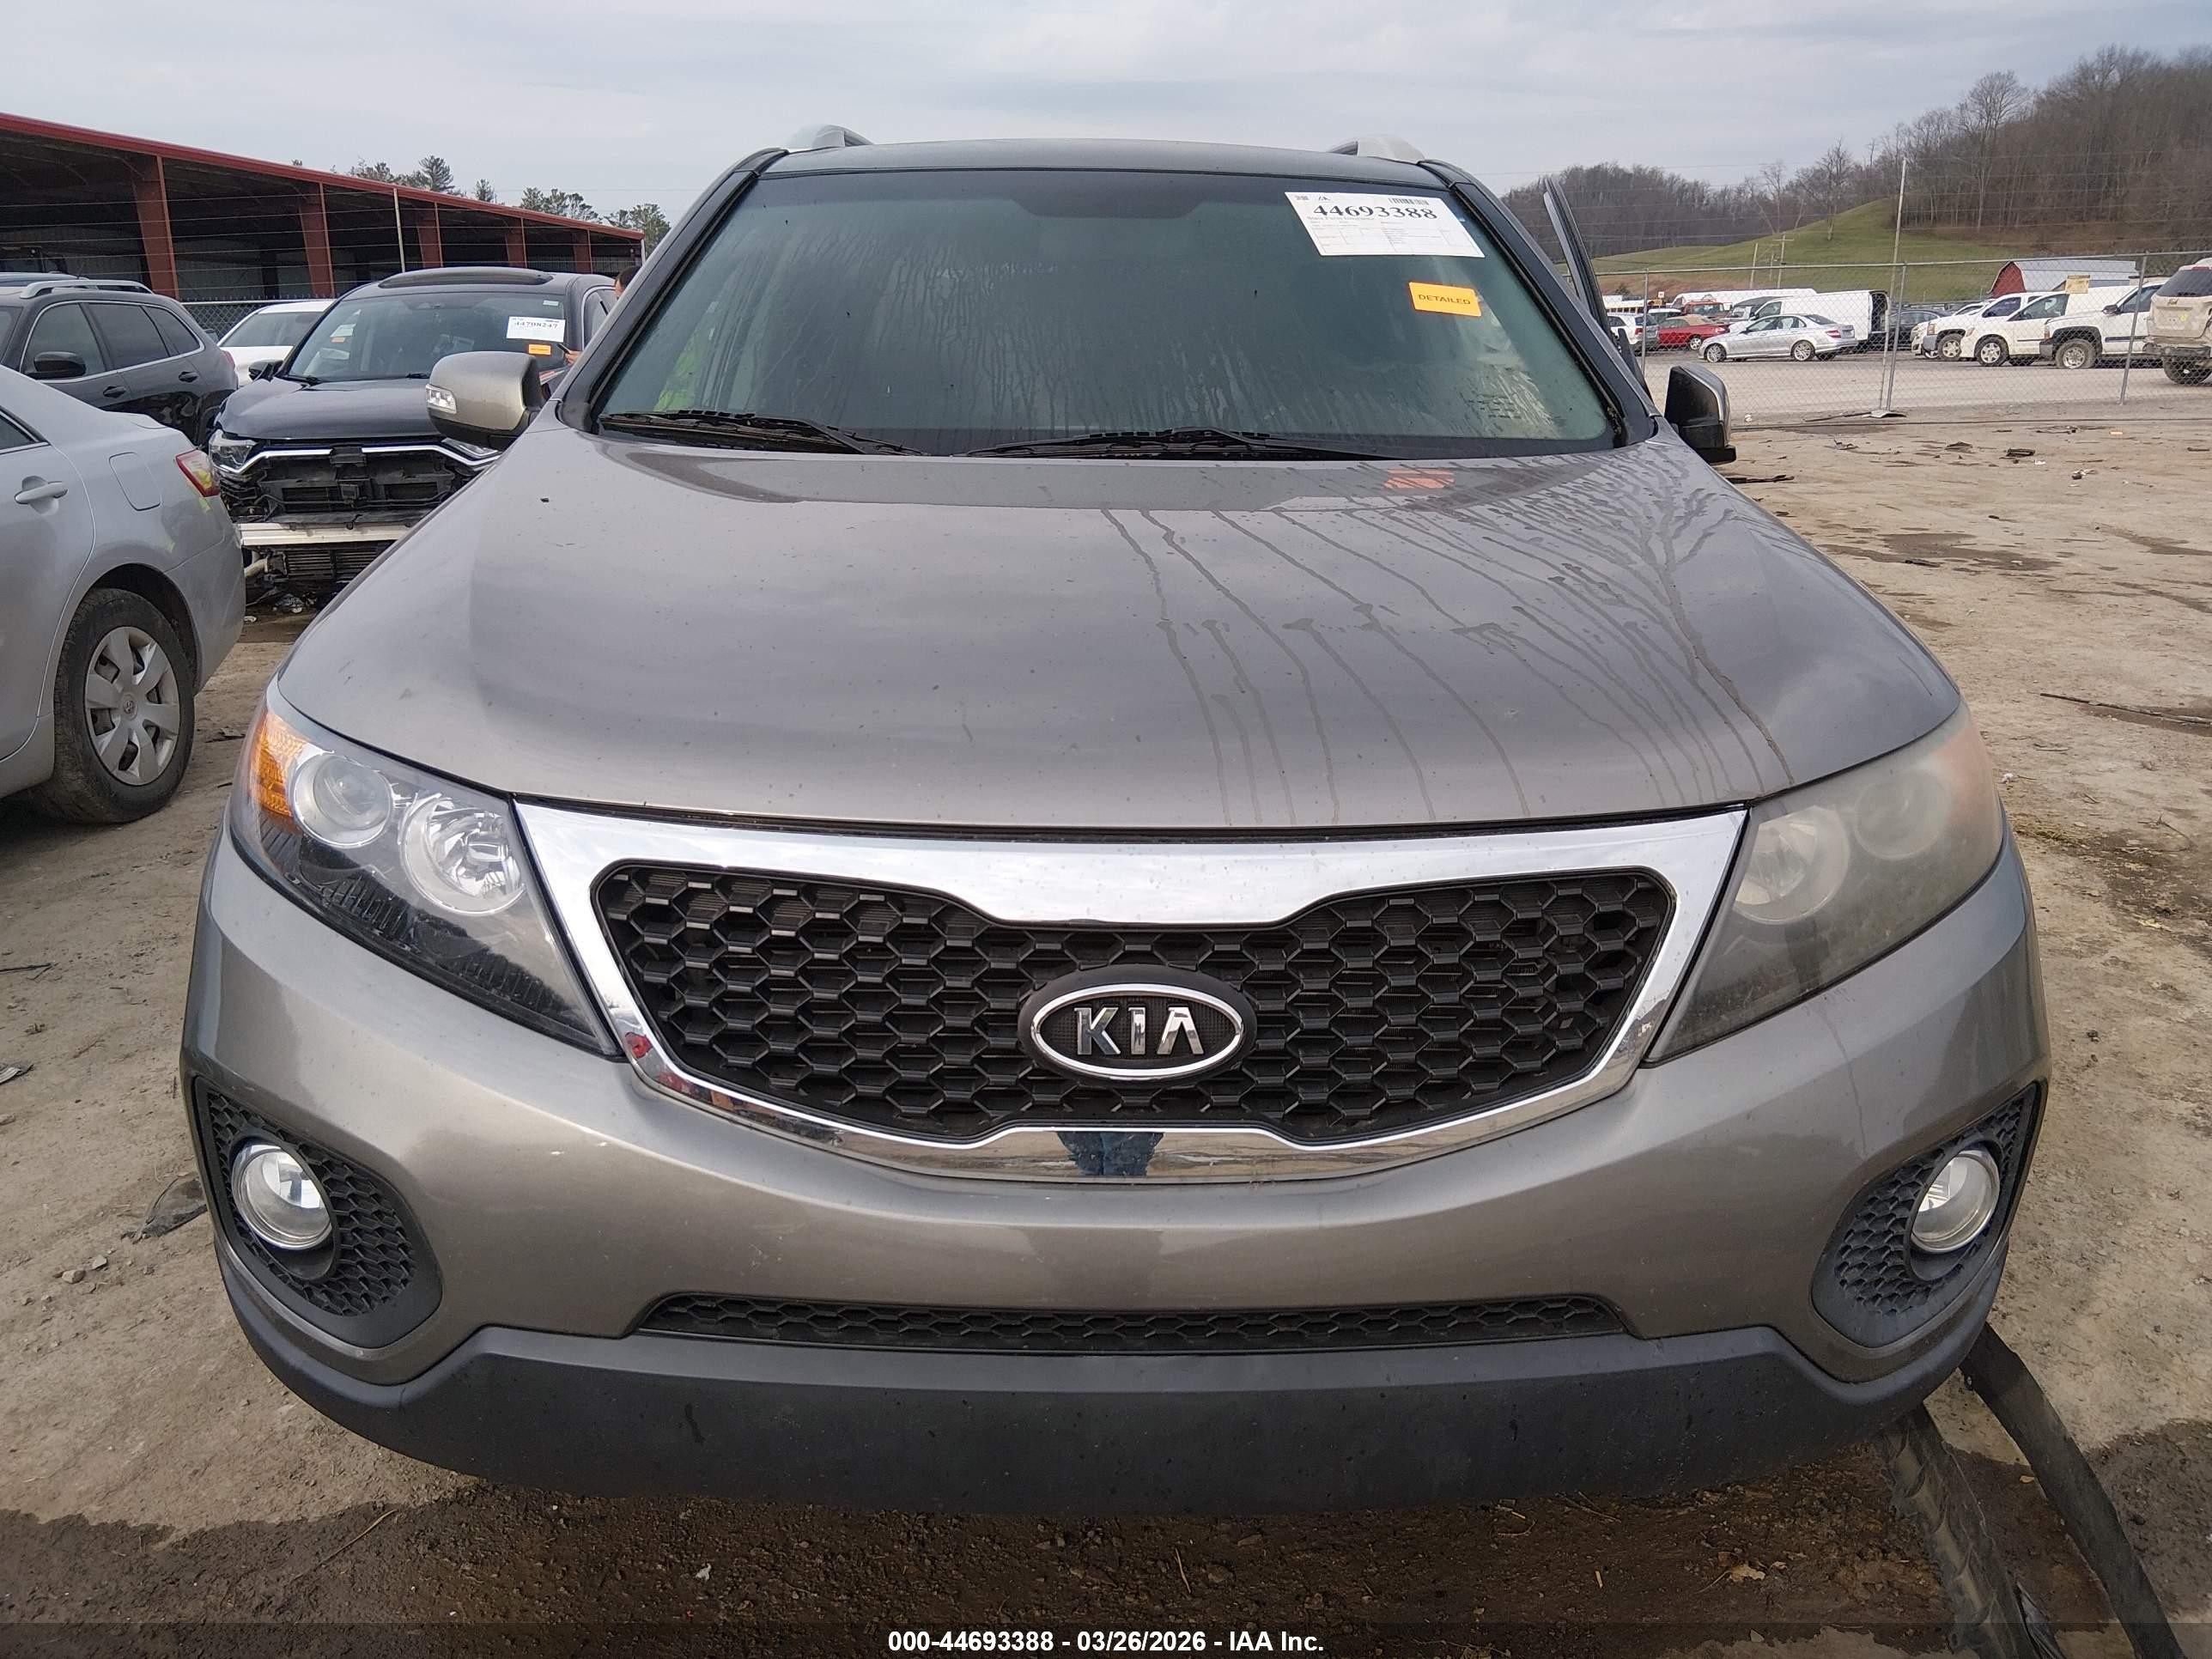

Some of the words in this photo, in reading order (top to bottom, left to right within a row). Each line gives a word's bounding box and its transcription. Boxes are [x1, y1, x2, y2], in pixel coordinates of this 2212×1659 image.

[1313, 204, 1438, 220] 44693388
[1418, 294, 1471, 305] DETAILED
[1073, 1006, 1205, 1055] KIA
